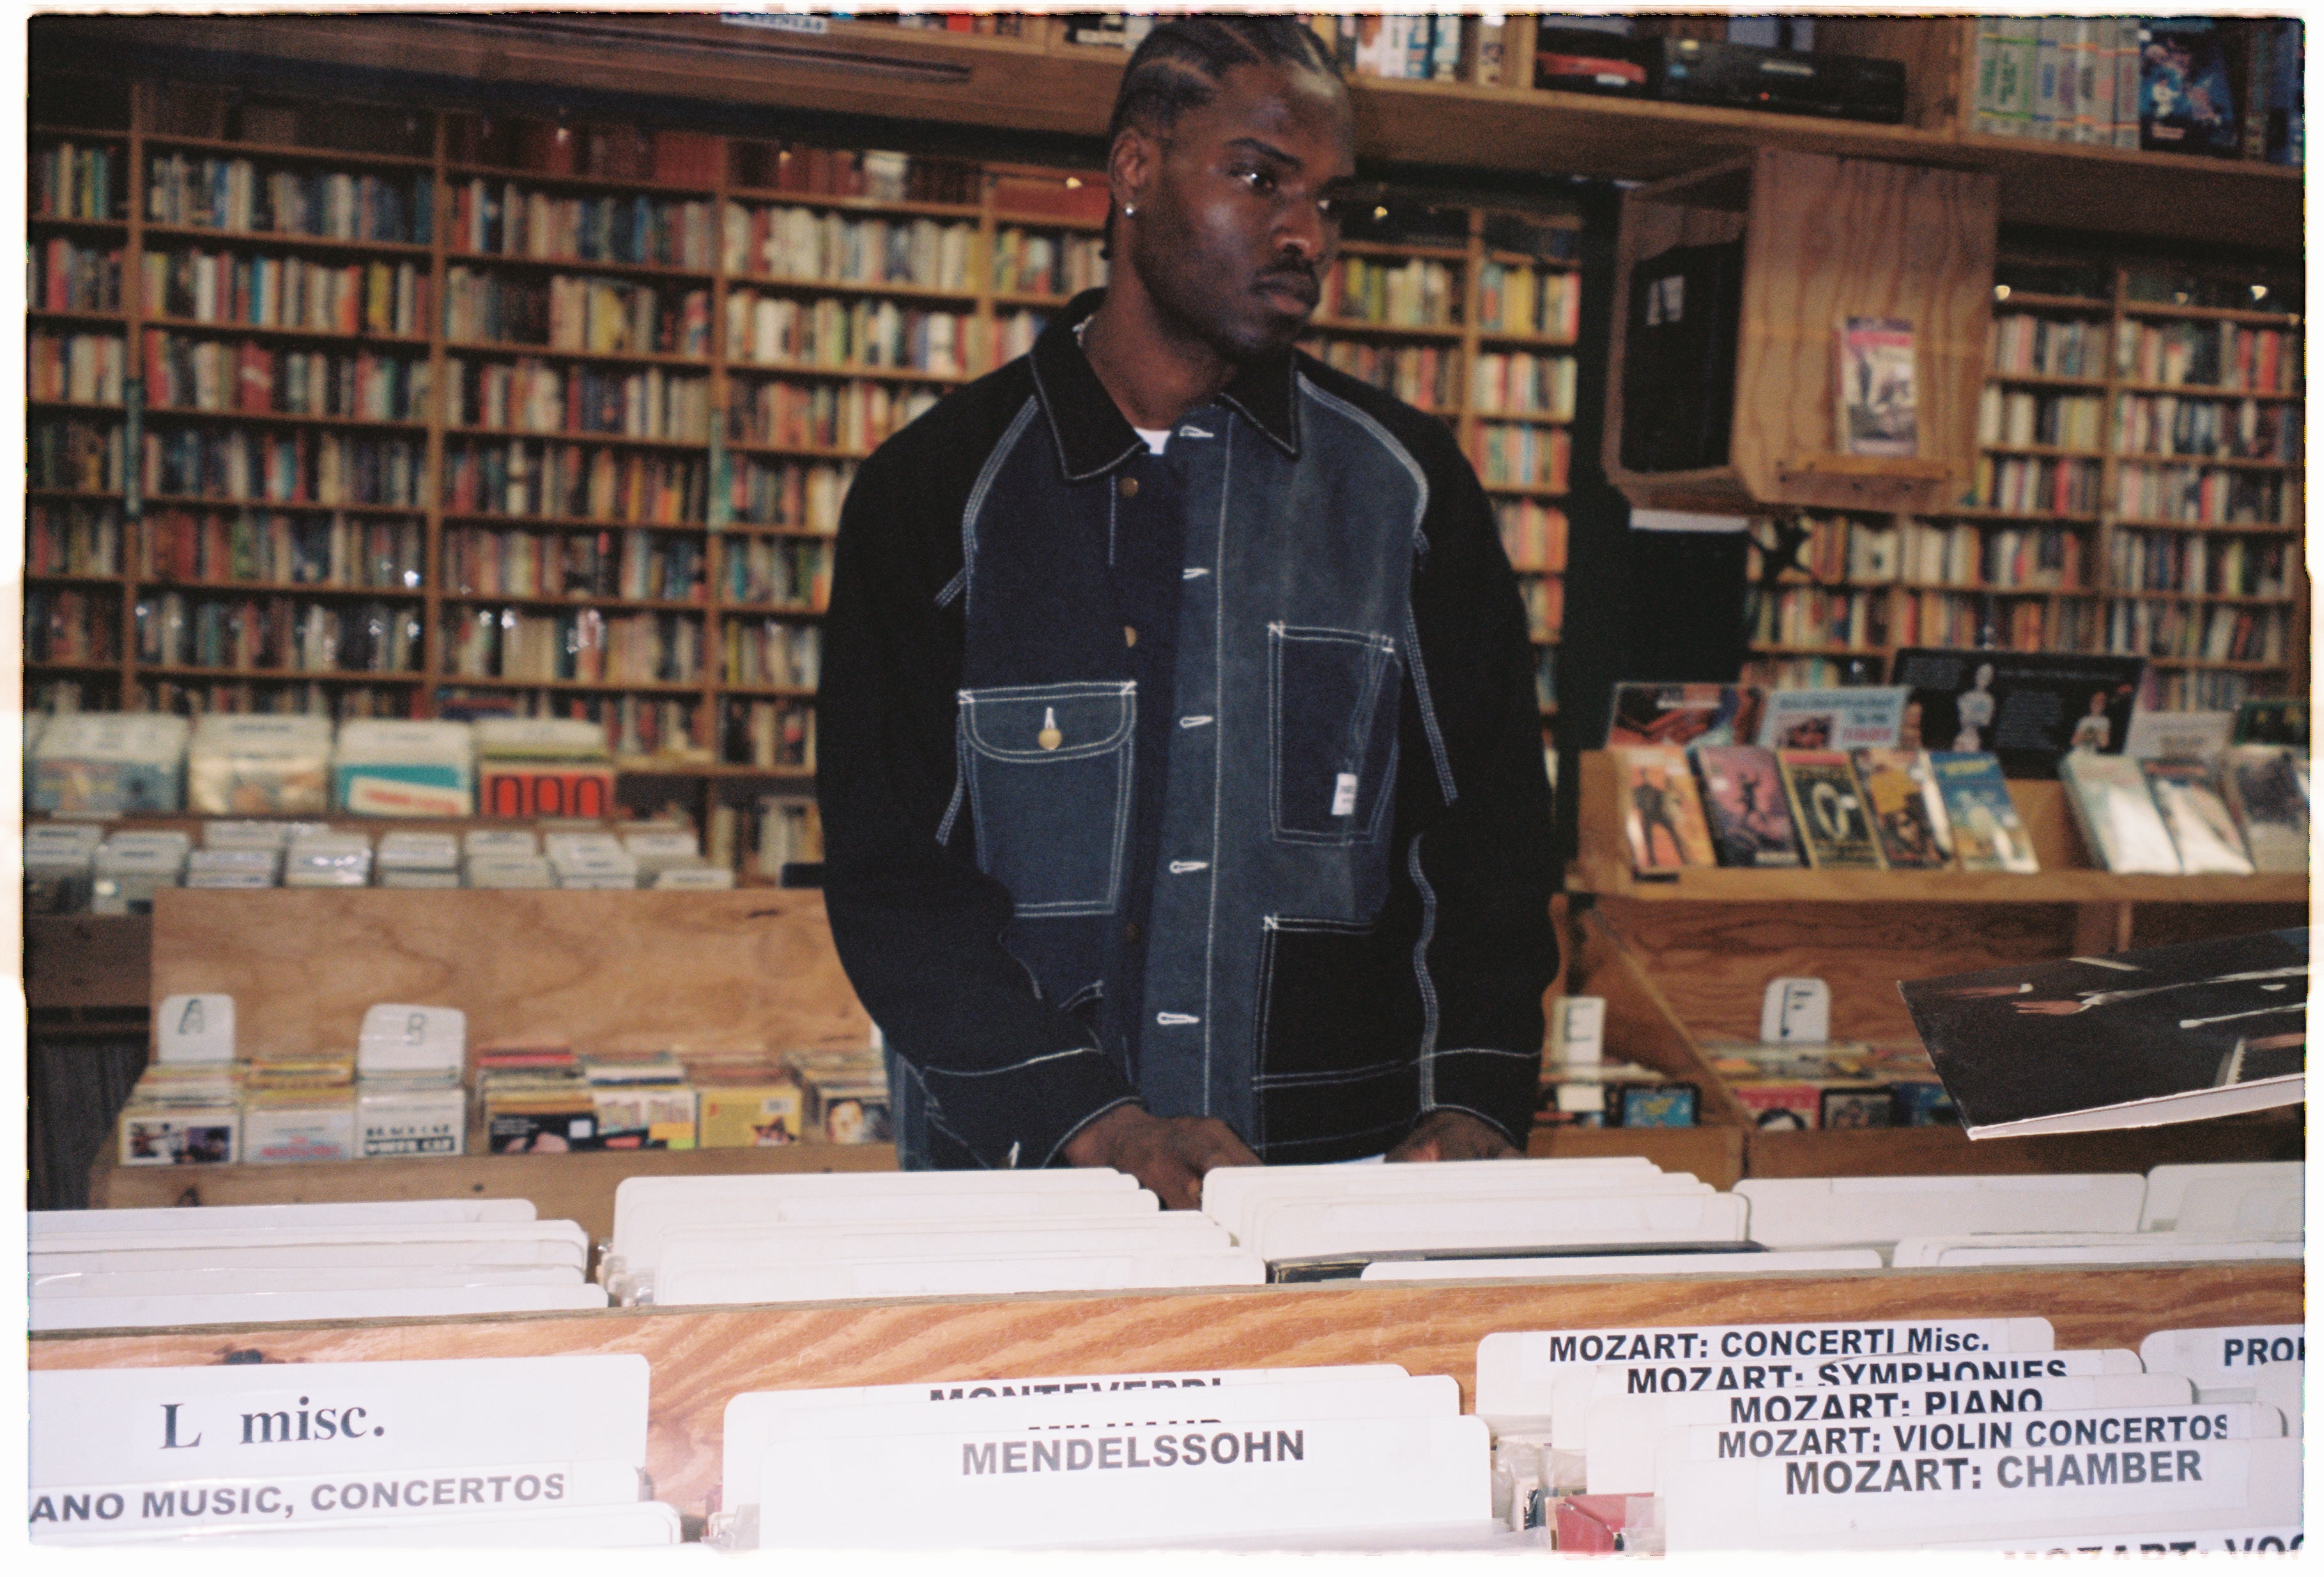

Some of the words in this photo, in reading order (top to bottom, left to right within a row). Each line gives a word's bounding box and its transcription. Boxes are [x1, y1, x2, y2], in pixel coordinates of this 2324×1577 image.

[1549, 1332, 1708, 1362] MOZART:
[1720, 1328, 1894, 1358] CONCERTI
[1907, 1327, 1989, 1353] Misc.
[2224, 1337, 2305, 1367] PRO
[1627, 1365, 1804, 1394] MOZART:
[1817, 1358, 2068, 1387] SYMPHONIES
[160, 1403, 202, 1450] L
[240, 1396, 386, 1445] misc.
[1730, 1392, 1911, 1424] MOZART:
[1925, 1387, 2043, 1415] PIANO
[962, 1429, 1307, 1475] MENDELSSOHN
[1718, 1426, 1881, 1459] MOZART:
[1893, 1421, 2013, 1452] VIOLIN
[2025, 1413, 2229, 1448] CONCERTOS
[1785, 1457, 1982, 1495] MOZART:
[1996, 1449, 2204, 1489] CHAMBER
[141, 1487, 294, 1519] MUSIC,
[310, 1473, 565, 1512] CONCERTOS
